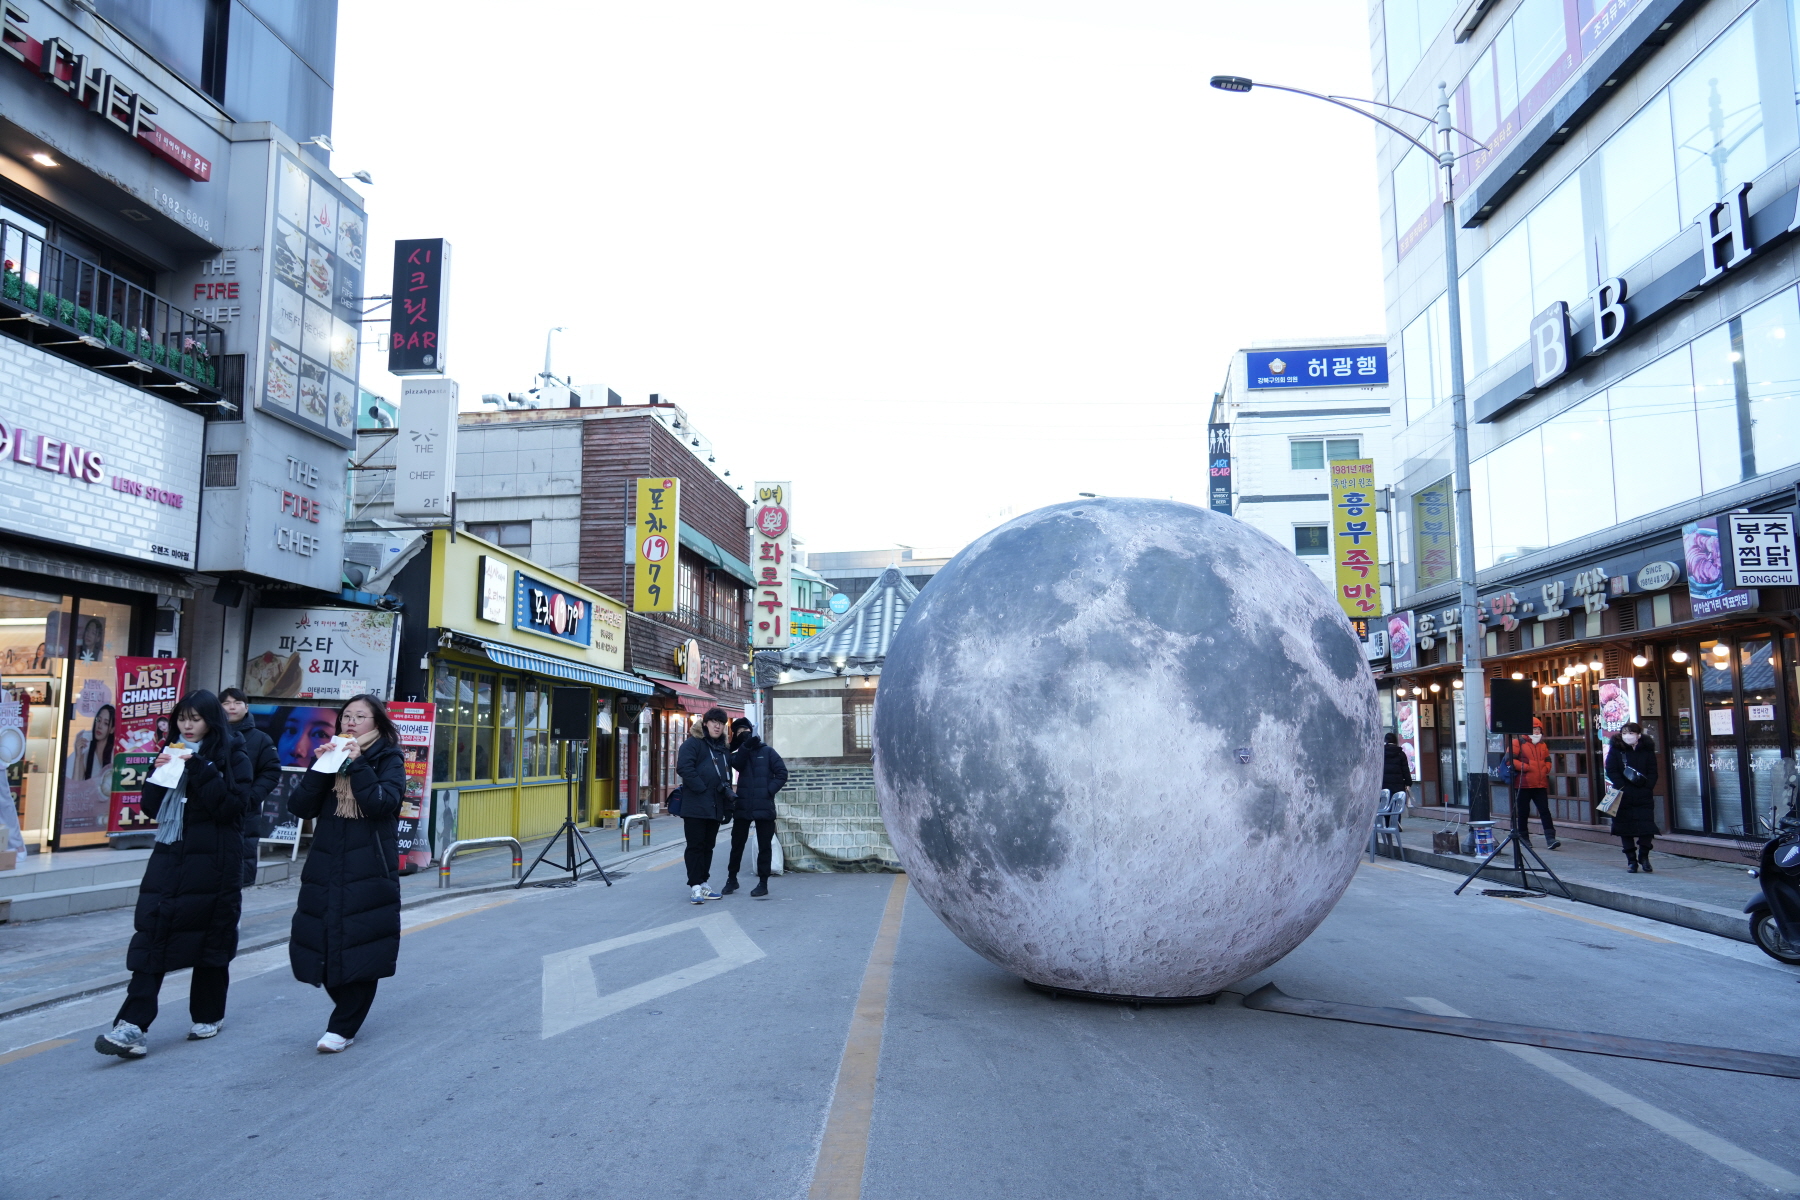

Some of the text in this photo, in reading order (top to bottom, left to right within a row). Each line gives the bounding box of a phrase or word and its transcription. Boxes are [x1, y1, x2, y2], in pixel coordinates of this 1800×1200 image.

[41, 37, 158, 137] CHEF
[194, 157, 208, 173] 2F
[162, 193, 210, 232] 982-6808
[201, 258, 236, 276] THE
[343, 276, 353, 289] THE
[403, 247, 431, 325] 시크릿
[194, 282, 240, 300] FIRE
[341, 287, 353, 299] FIRE
[341, 298, 353, 309] CHEF
[192, 306, 240, 323] CHEF
[281, 307, 293, 322] THE
[393, 331, 436, 350] BAR
[424, 356, 434, 364] 3F
[1308, 355, 1377, 378] 허광행
[1257, 377, 1286, 385] 강북구의회
[404, 387, 448, 396] pizza&pasta
[414, 444, 434, 453] THE
[287, 454, 319, 491] THE
[409, 471, 436, 480] CHEF
[1210, 467, 1231, 477] BAR
[1331, 463, 1373, 474] 1981년 개업
[1332, 477, 1373, 489] 족발의 원조
[112, 475, 184, 509] LENS STORE
[281, 490, 321, 525] FIRE
[423, 498, 439, 508] 2F
[1737, 522, 1789, 544] 봉추
[277, 527, 320, 558] CHEF
[150, 543, 170, 557] 오렌즈
[1337, 491, 1377, 612] 흥부족발
[1739, 545, 1791, 567] 찜닭
[1645, 564, 1662, 575] SINCE
[1742, 575, 1793, 584] BONGCHU
[1693, 593, 1748, 614] 미아삼거리 대표맛집
[278, 635, 334, 654] 파스타
[308, 658, 359, 677] &피자
[123, 668, 176, 691] LAST
[122, 687, 176, 704] CHANCE
[307, 686, 340, 695] 이태리피자
[370, 688, 381, 697] 2F
[407, 695, 417, 703] 17
[0, 709, 18, 717] HINE
[622, 703, 641, 711] TERRA
[0, 718, 22, 727] OUCH
[125, 756, 148, 765] 원데이
[122, 795, 144, 804] 한달
